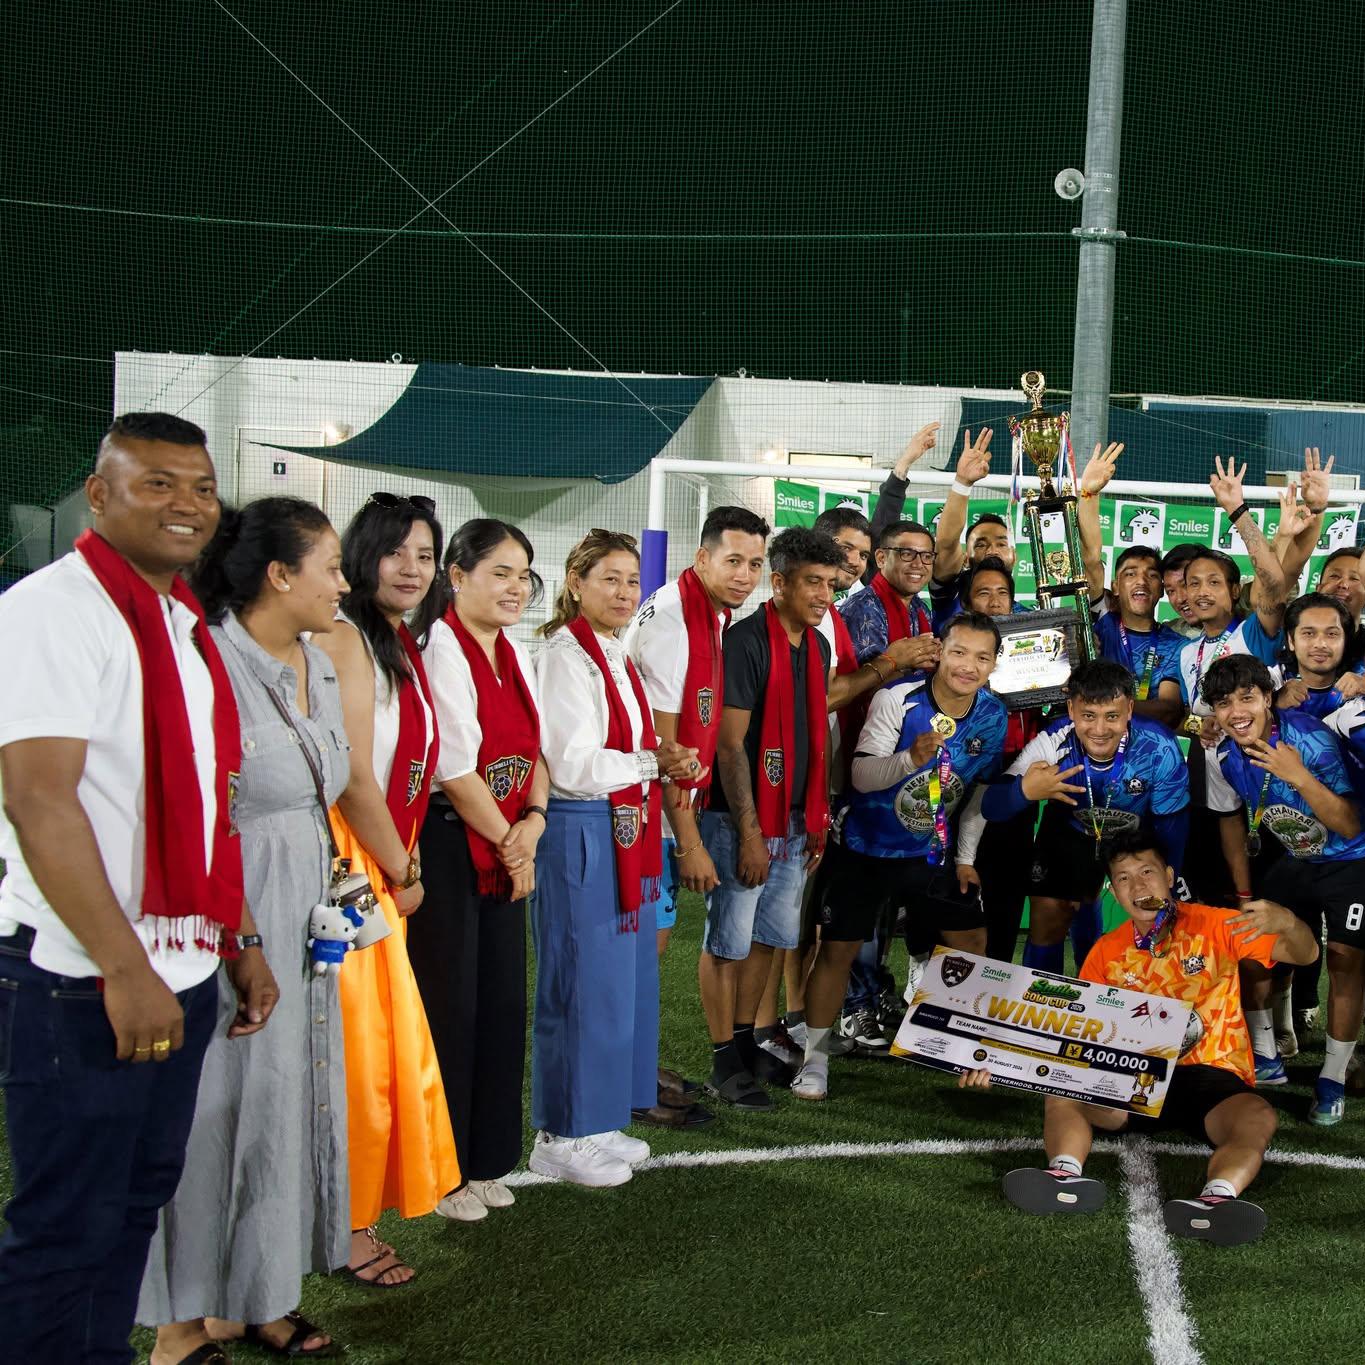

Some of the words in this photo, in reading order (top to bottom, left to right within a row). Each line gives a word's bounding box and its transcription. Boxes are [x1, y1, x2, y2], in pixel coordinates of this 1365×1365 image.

[777, 493, 815, 510] Smiles
[1169, 519, 1209, 533] Smiles
[904, 775, 925, 793] NEW
[904, 817, 934, 828] RESTAURA
[1271, 806, 1316, 827] CHAUTARI
[1346, 902, 1364, 931] 8
[983, 966, 1012, 980] Smiles
[1029, 979, 1082, 1000] Smiles
[1023, 991, 1048, 1006] GOLD
[1048, 997, 1068, 1009] CUP
[1070, 1003, 1084, 1011] 2026
[1096, 994, 1125, 1006] Smiles
[956, 1020, 970, 1028] TEAM
[970, 1024, 988, 1033] NAME:
[987, 996, 1104, 1041] WINNER
[1070, 1046, 1079, 1056] ¥
[1083, 1048, 1149, 1071] 4,00,000
[990, 1075, 1033, 1090] ROTHERHOOD,
[1066, 1091, 1093, 1101] HEALTH
